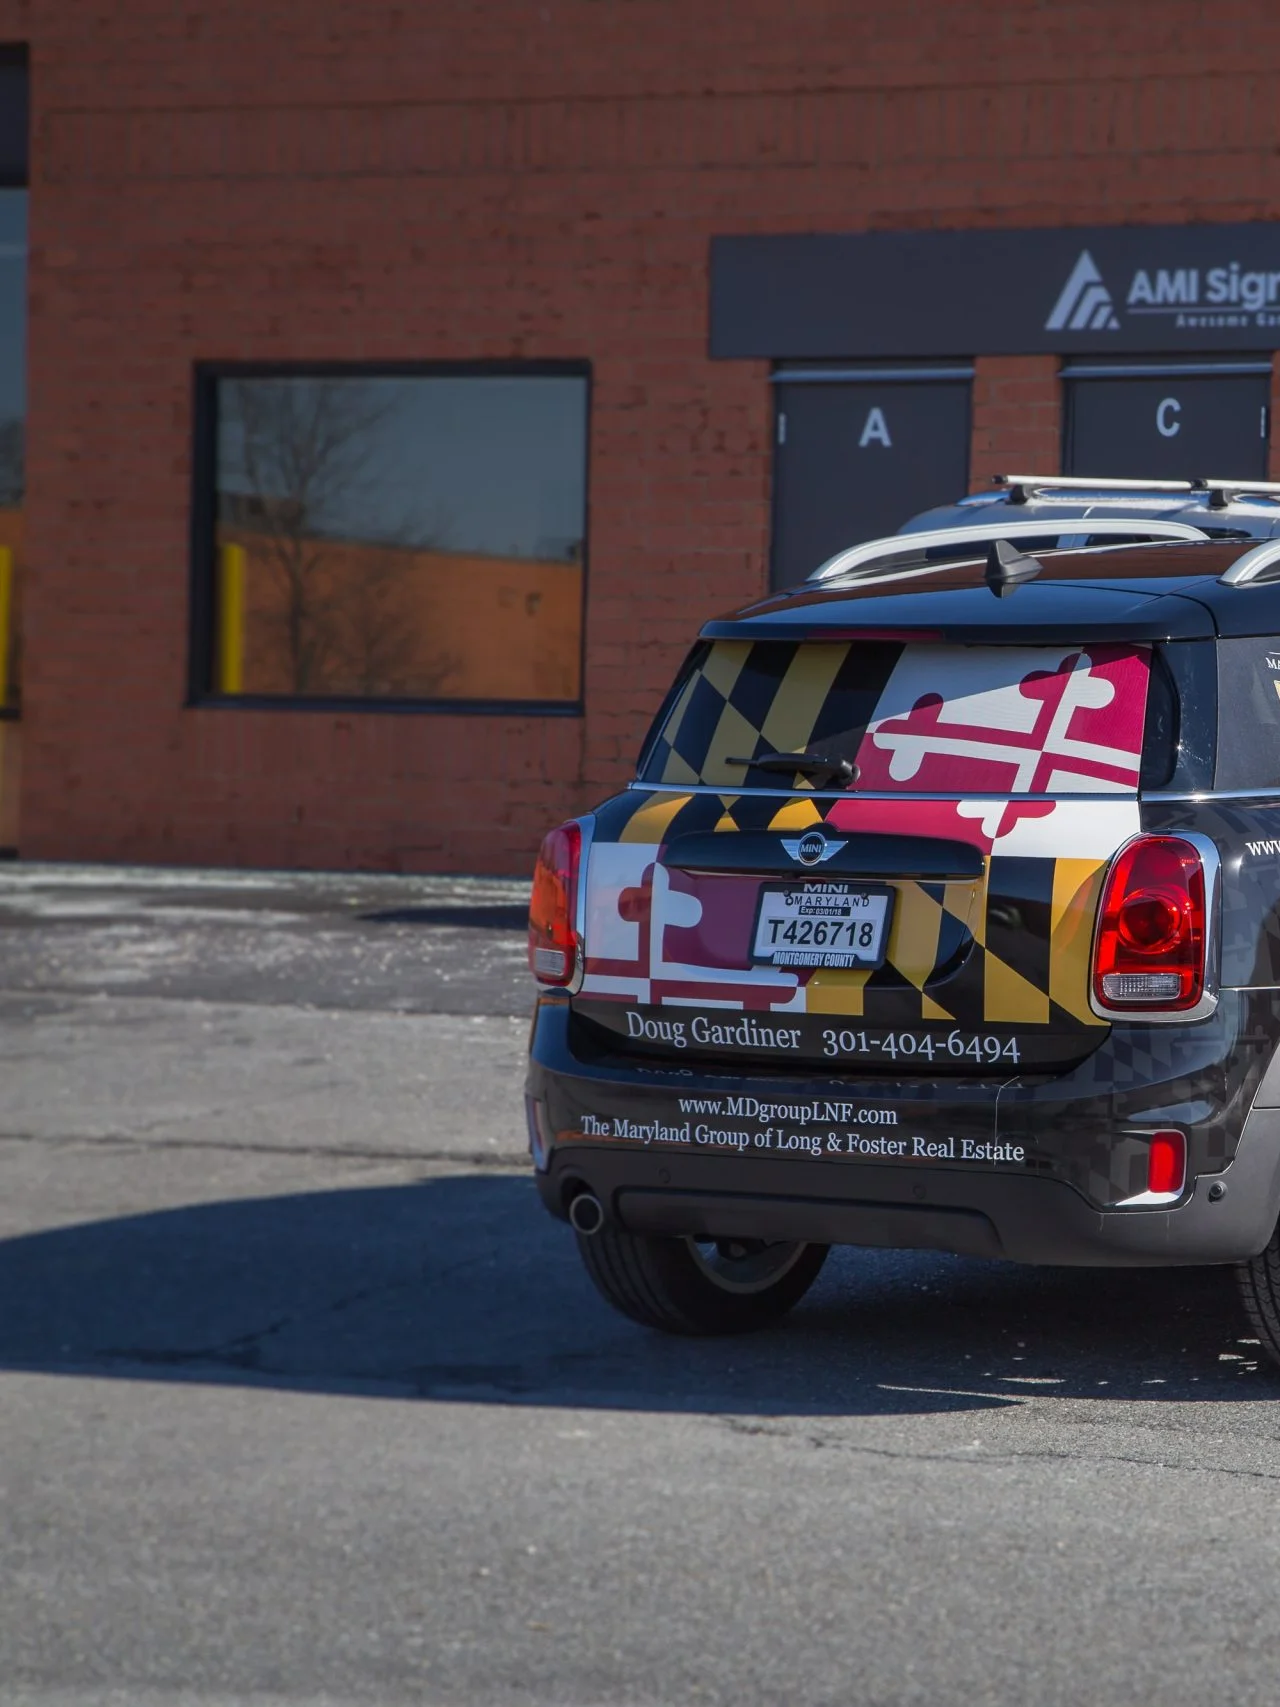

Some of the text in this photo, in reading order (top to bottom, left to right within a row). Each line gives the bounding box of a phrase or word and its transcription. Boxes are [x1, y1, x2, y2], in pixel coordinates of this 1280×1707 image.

[1126, 269, 1198, 304] AMI
[1176, 313, 1248, 328] Awesome
[859, 407, 892, 447] A
[1156, 398, 1182, 437] C
[801, 843, 821, 853] MINI
[794, 896, 870, 907] MARYLAND
[803, 883, 849, 894] MINI
[768, 920, 873, 947] T426718
[772, 951, 855, 967] MONTGOMERY COUNTY
[626, 1011, 1021, 1064] Doug Gardiner 301-404-6494
[678, 1097, 898, 1125] www.MDgroupLNF.com
[580, 1115, 1025, 1161] The Maryland Group of Long & Foster Real Estate
